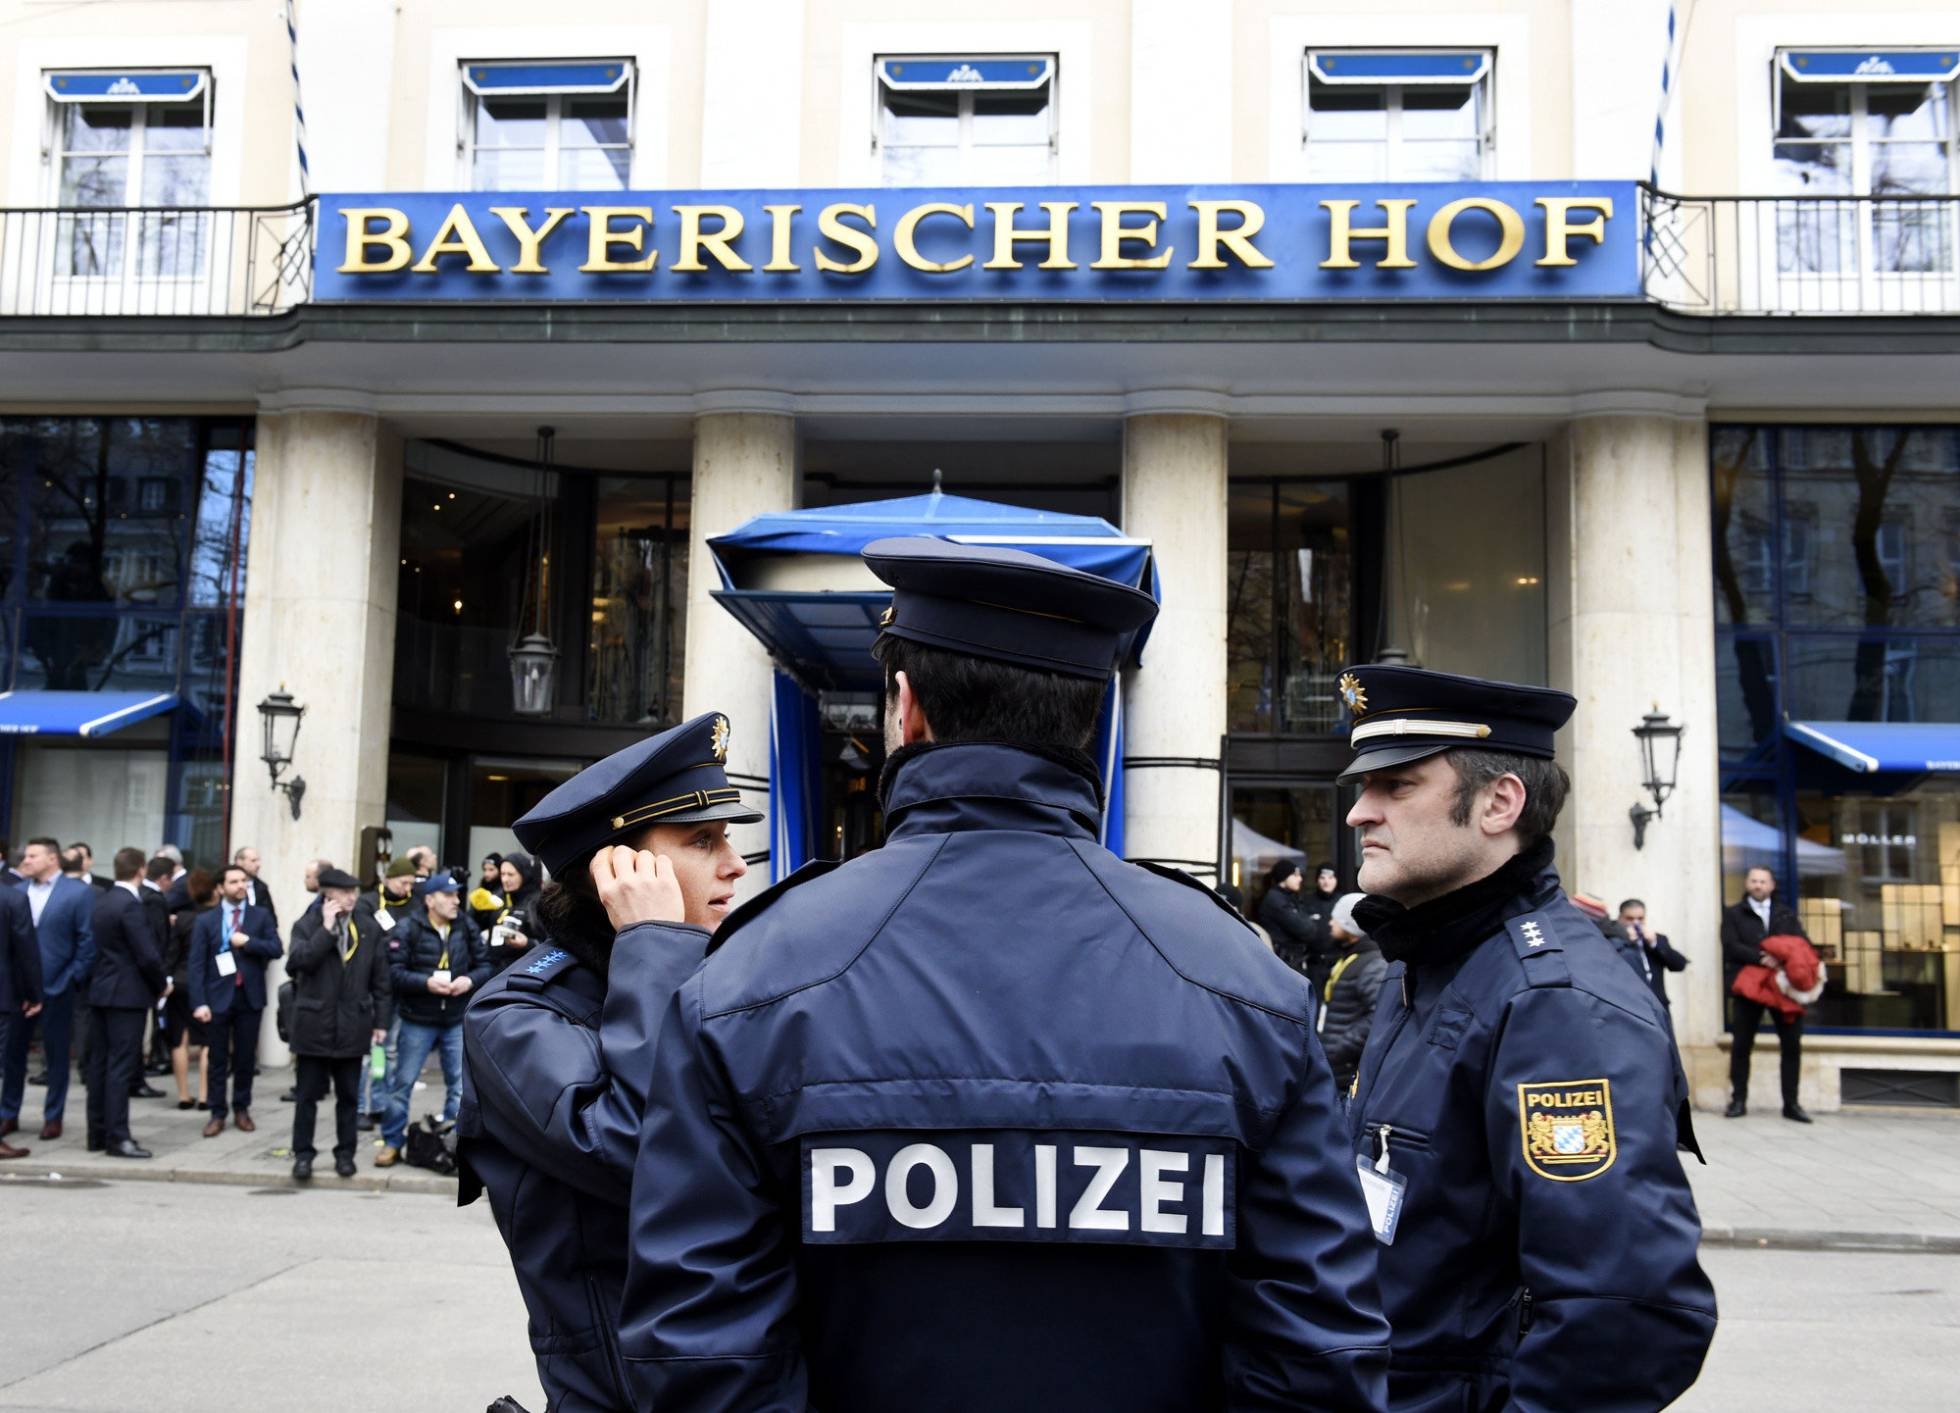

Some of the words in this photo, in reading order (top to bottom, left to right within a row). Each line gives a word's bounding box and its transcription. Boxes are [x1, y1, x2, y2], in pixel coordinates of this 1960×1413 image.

[336, 200, 1275, 273] BAYERISCHER
[1318, 197, 1613, 271] HOF
[1527, 1090, 1603, 1107] POLIZEI
[811, 1143, 1224, 1235] POLIZEI
[1383, 1187, 1399, 1233] POLIZEI
